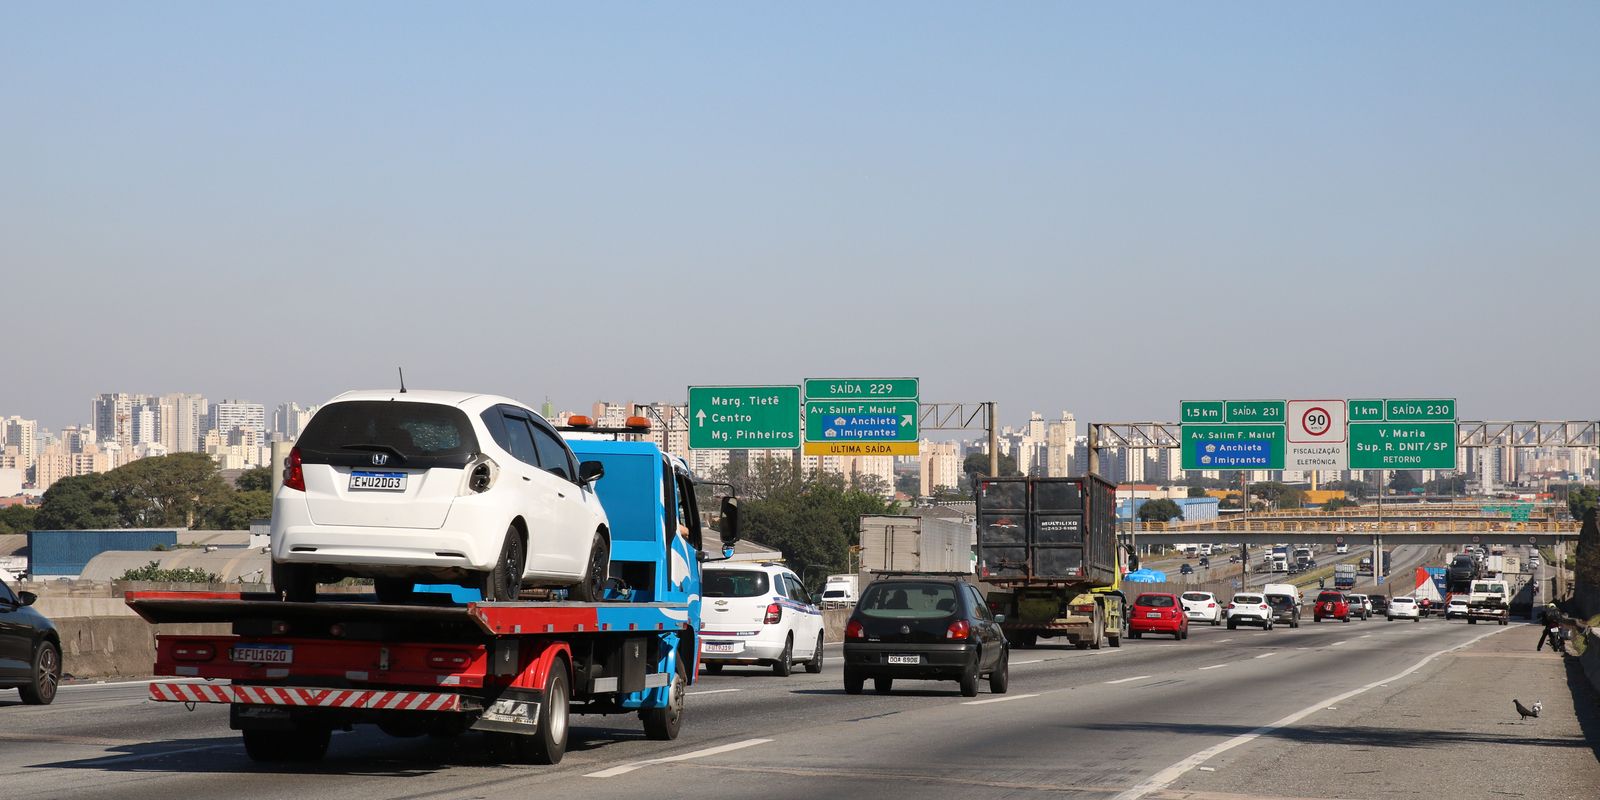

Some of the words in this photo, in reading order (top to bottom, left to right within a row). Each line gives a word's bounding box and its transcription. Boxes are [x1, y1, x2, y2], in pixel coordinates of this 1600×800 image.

[830, 381, 862, 393] SAÍDA
[870, 384, 892, 393] 229
[712, 397, 744, 407] Marg.
[750, 396, 779, 405] Tietê
[1202, 408, 1218, 416] km
[1232, 406, 1257, 416] SAÍDA
[1392, 404, 1422, 414] SAÍDA
[1426, 406, 1449, 414] 230
[712, 414, 751, 422] Centro
[1308, 415, 1325, 426] 90
[712, 430, 732, 441] Mg.
[736, 430, 794, 439] Pinheiros
[840, 429, 896, 438] Imigrantes
[1379, 430, 1390, 438] V.
[1394, 430, 1425, 438] Maria
[831, 443, 860, 453] ÚLTIMA
[865, 443, 892, 453] SAÍDA
[1357, 443, 1380, 453] Sup.
[1398, 442, 1448, 451] DNIT/SP
[1214, 456, 1266, 465] Imigrantes
[1297, 456, 1336, 465] ELETRÔNICA
